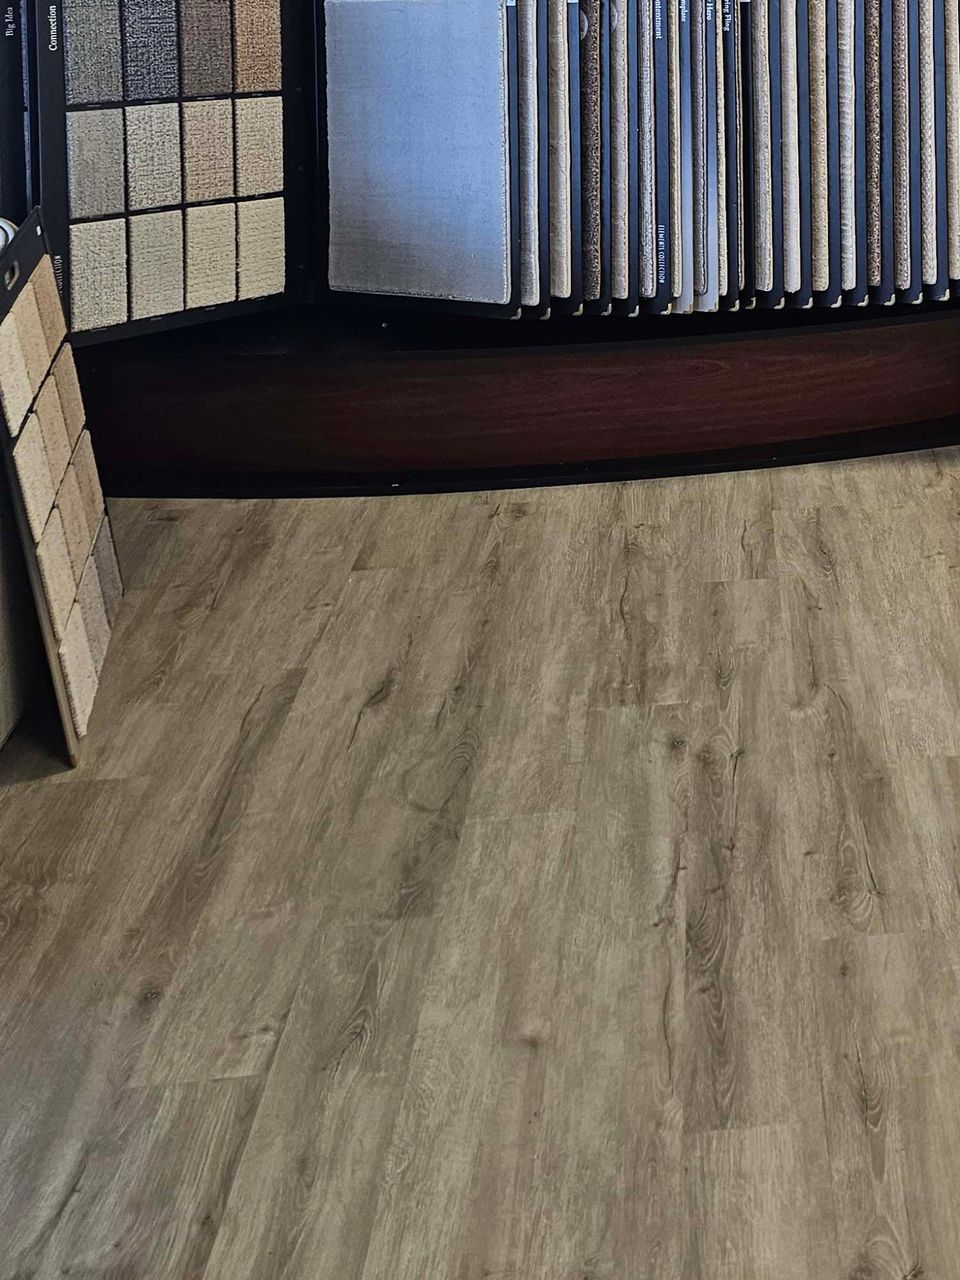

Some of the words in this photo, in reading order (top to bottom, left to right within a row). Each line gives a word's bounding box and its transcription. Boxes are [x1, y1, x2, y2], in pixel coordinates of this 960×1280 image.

[5, 7, 13, 22] Idea
[706, 2, 714, 20] Hero
[5, 23, 16, 36] Big
[48, 5, 57, 51] Connection
[723, 14, 731, 32] Fling
